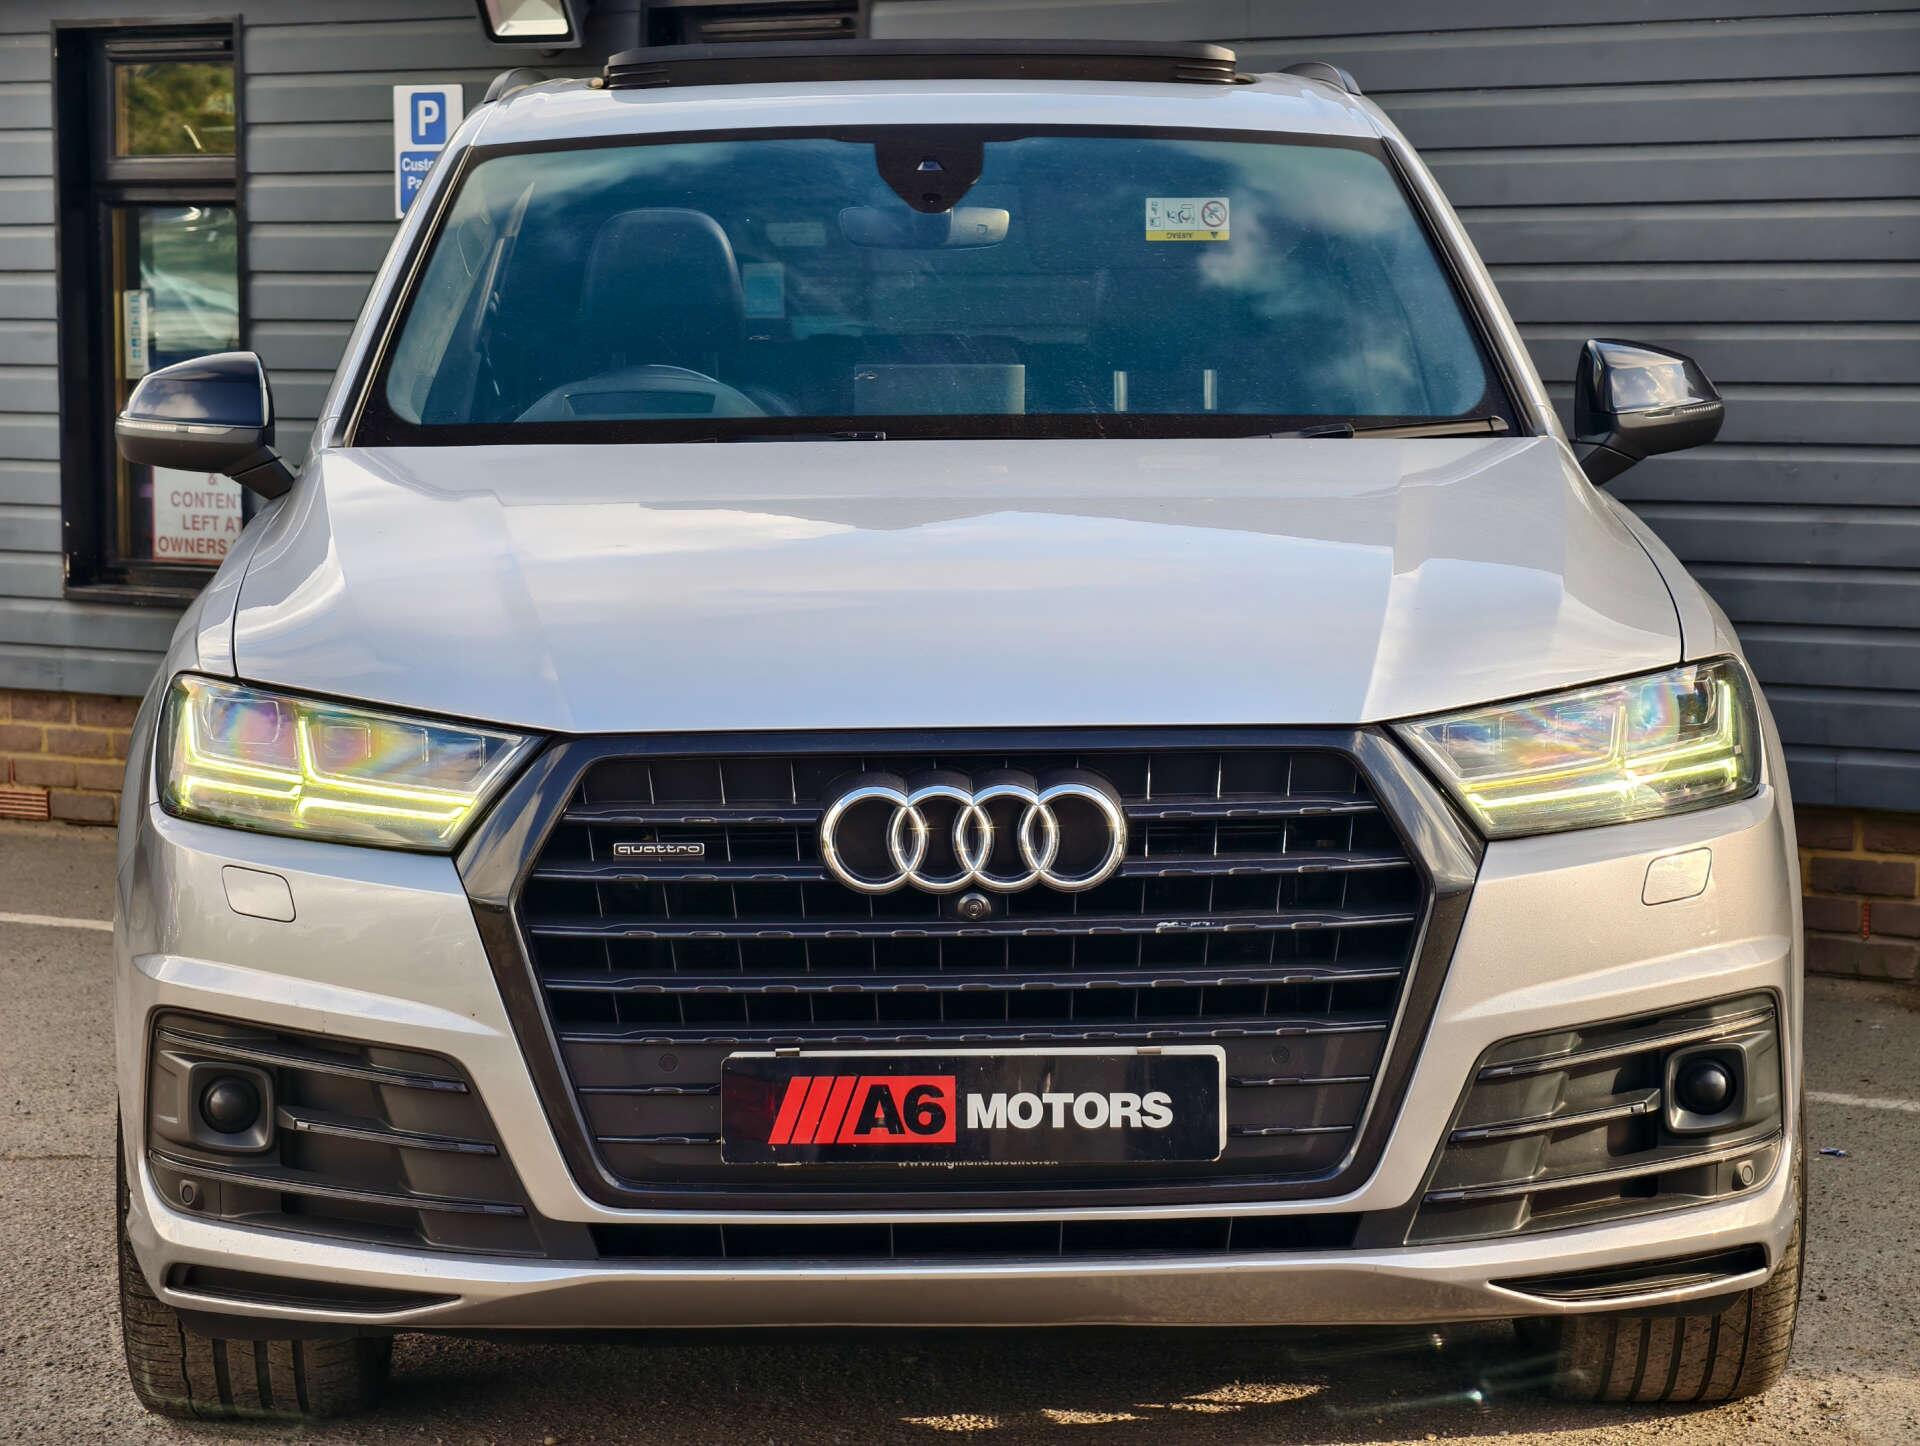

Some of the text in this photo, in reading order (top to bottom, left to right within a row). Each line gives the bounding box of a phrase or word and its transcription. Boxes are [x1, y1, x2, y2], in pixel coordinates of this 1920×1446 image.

[417, 100, 440, 136] P
[182, 514, 219, 531] LEFT
[158, 536, 227, 555] OWNERS
[617, 844, 700, 854] quattro
[854, 1083, 1173, 1136] A6 MOTORS
